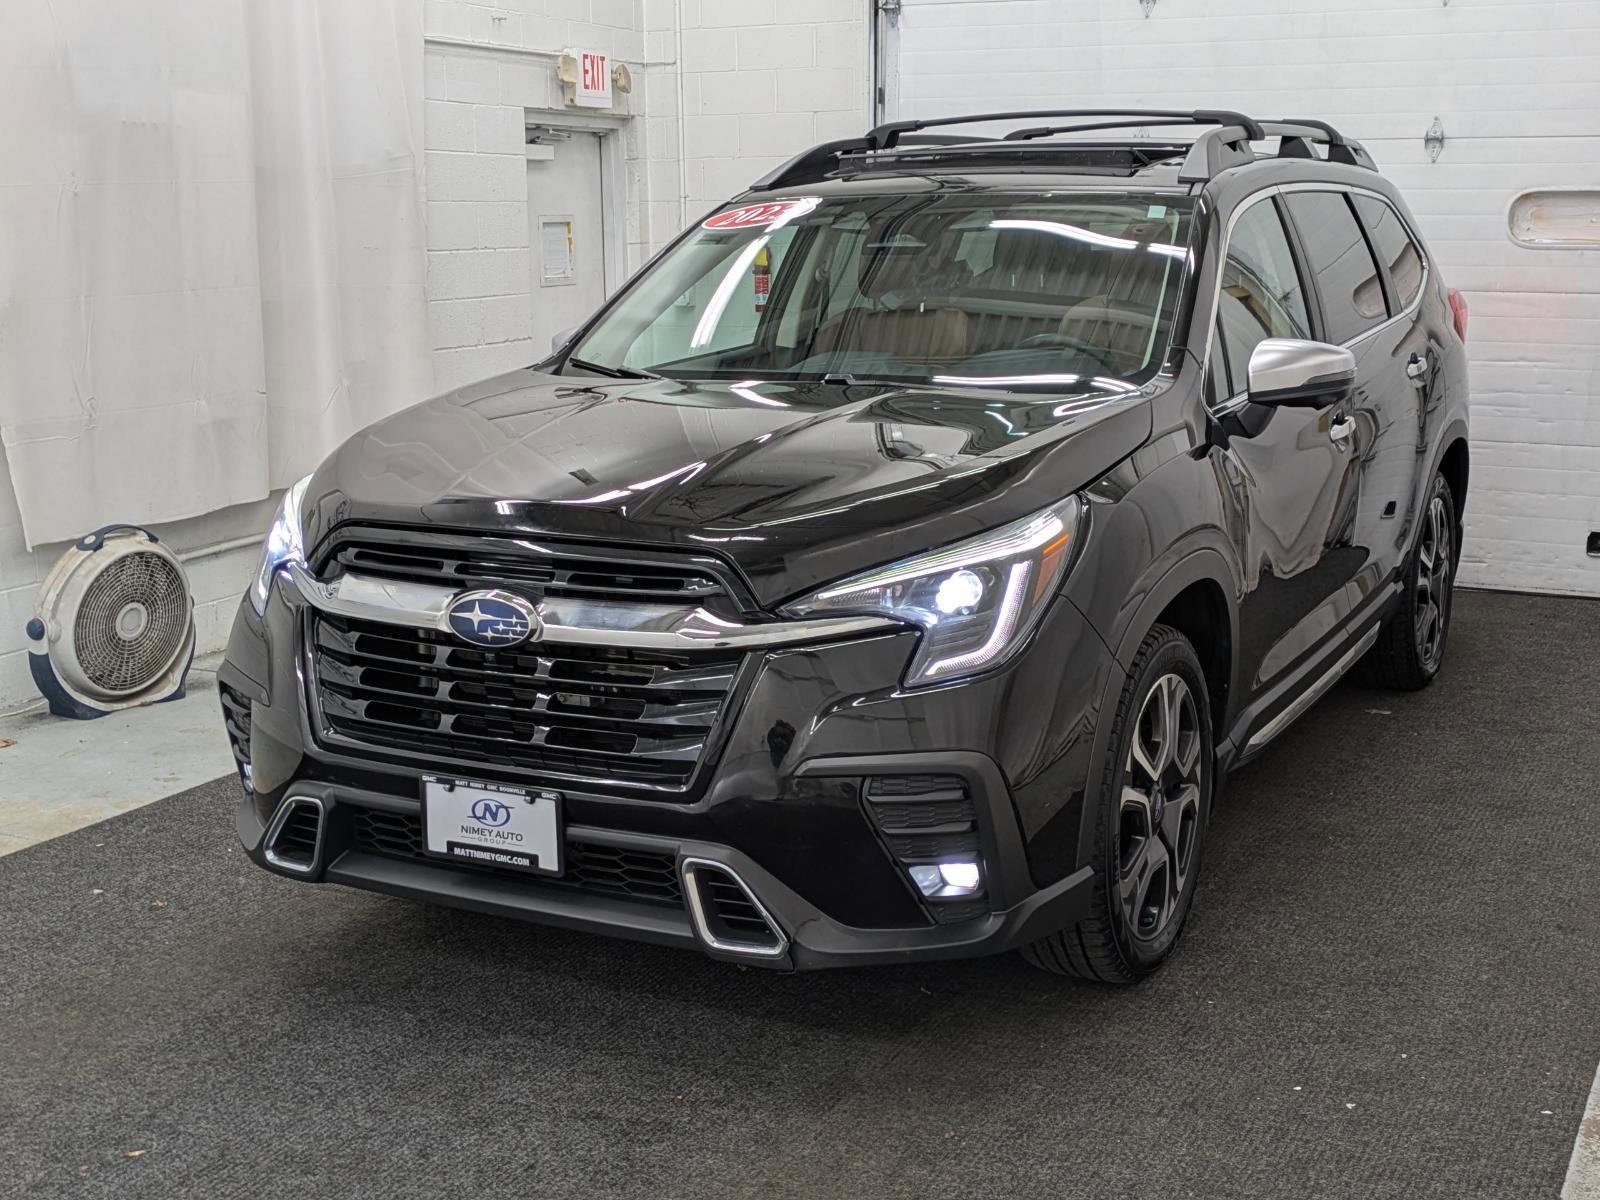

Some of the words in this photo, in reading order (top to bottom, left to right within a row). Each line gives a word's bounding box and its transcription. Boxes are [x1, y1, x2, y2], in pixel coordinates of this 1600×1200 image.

[583, 54, 606, 91] EXIT
[541, 792, 557, 800] GMC
[460, 825, 494, 838] NIMEY
[494, 830, 524, 842] AUTO
[477, 836, 507, 845] GROUP
[453, 847, 530, 867] MATTNIMEYGMC.COM
